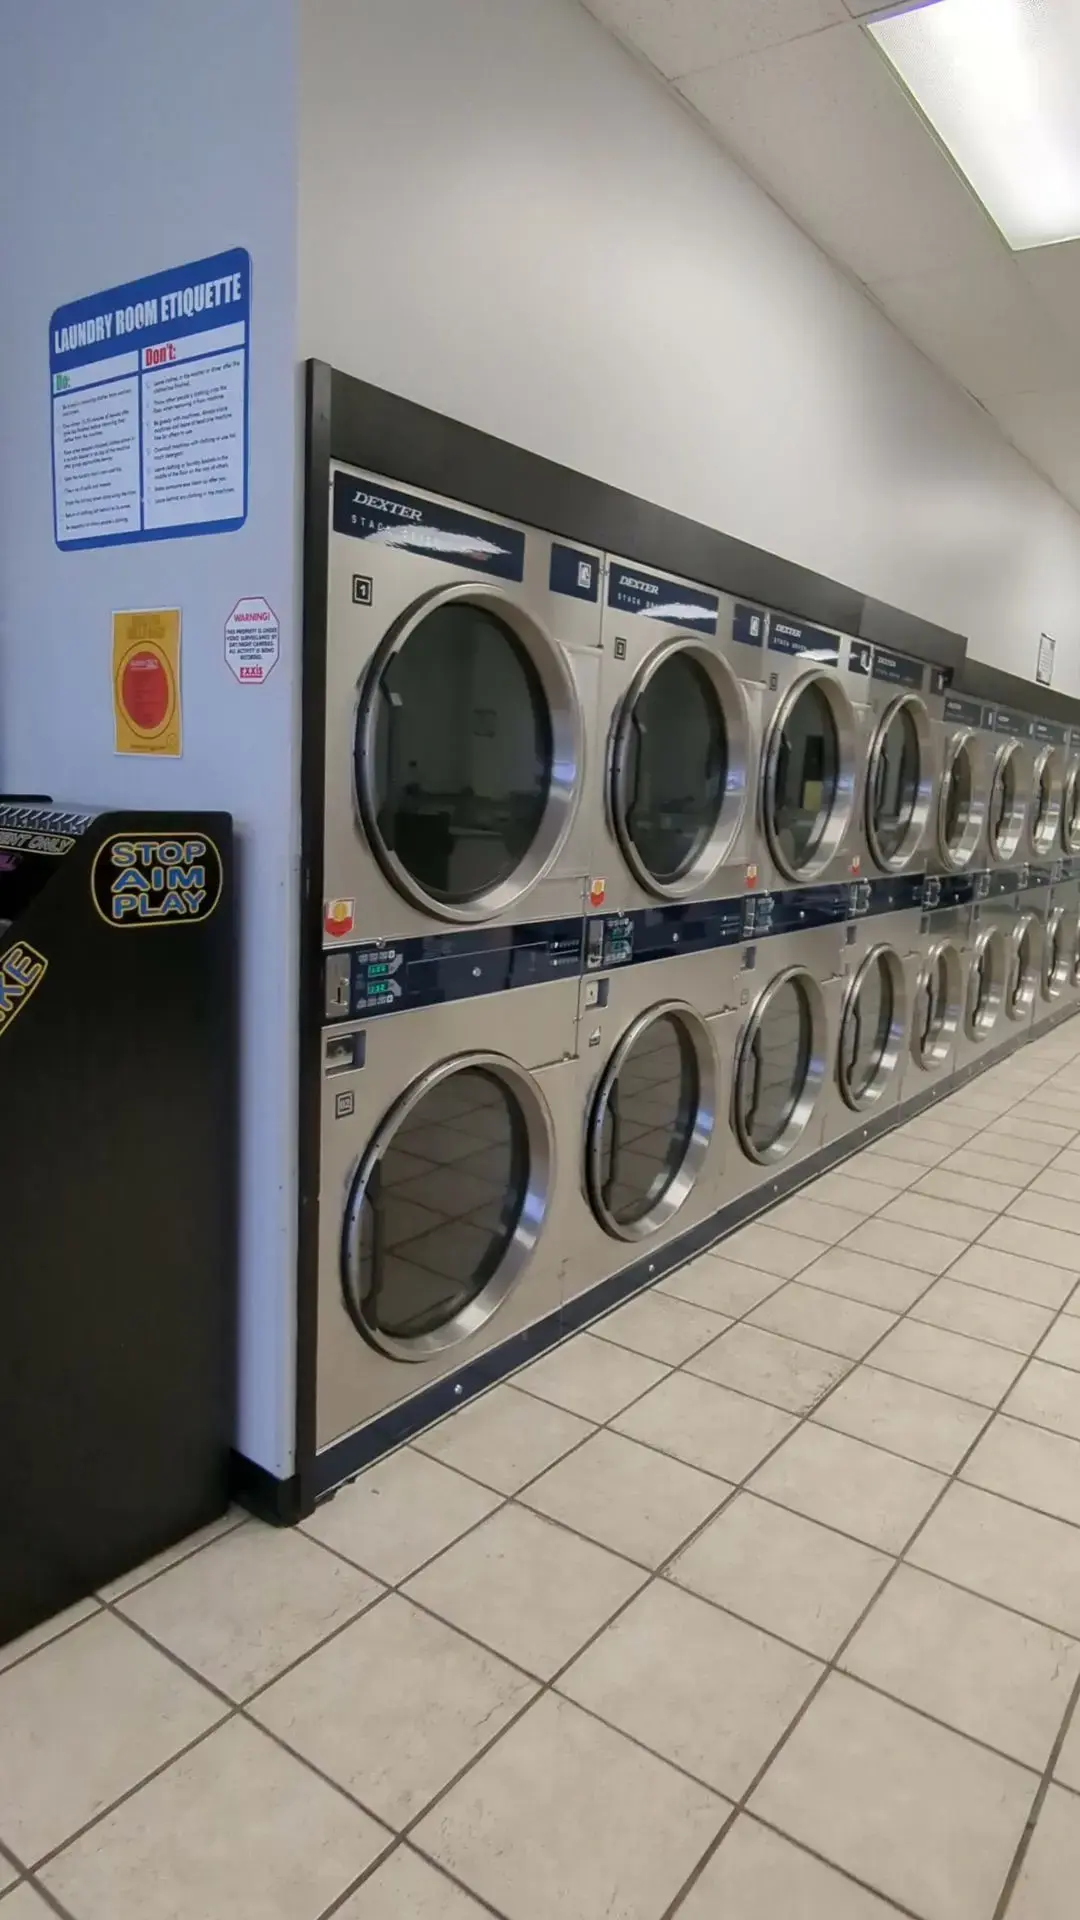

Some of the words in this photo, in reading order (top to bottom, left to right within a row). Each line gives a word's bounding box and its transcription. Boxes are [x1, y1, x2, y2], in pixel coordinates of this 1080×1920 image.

[54, 312, 113, 355] LAUNDRY
[115, 298, 158, 336] ROOM
[160, 272, 242, 323] ETIQUETTE
[144, 343, 177, 367] Don't:
[55, 374, 71, 391] Do:
[351, 490, 423, 522] DEXTER
[618, 575, 660, 596] DEXTER
[233, 612, 271, 622] WARNING!
[0, 831, 32, 847] ENT
[28, 835, 72, 853] ONLY
[110, 840, 207, 868] STOP
[110, 865, 206, 893] AIM
[111, 889, 208, 920] PLAY
[0, 948, 43, 1023] KE
